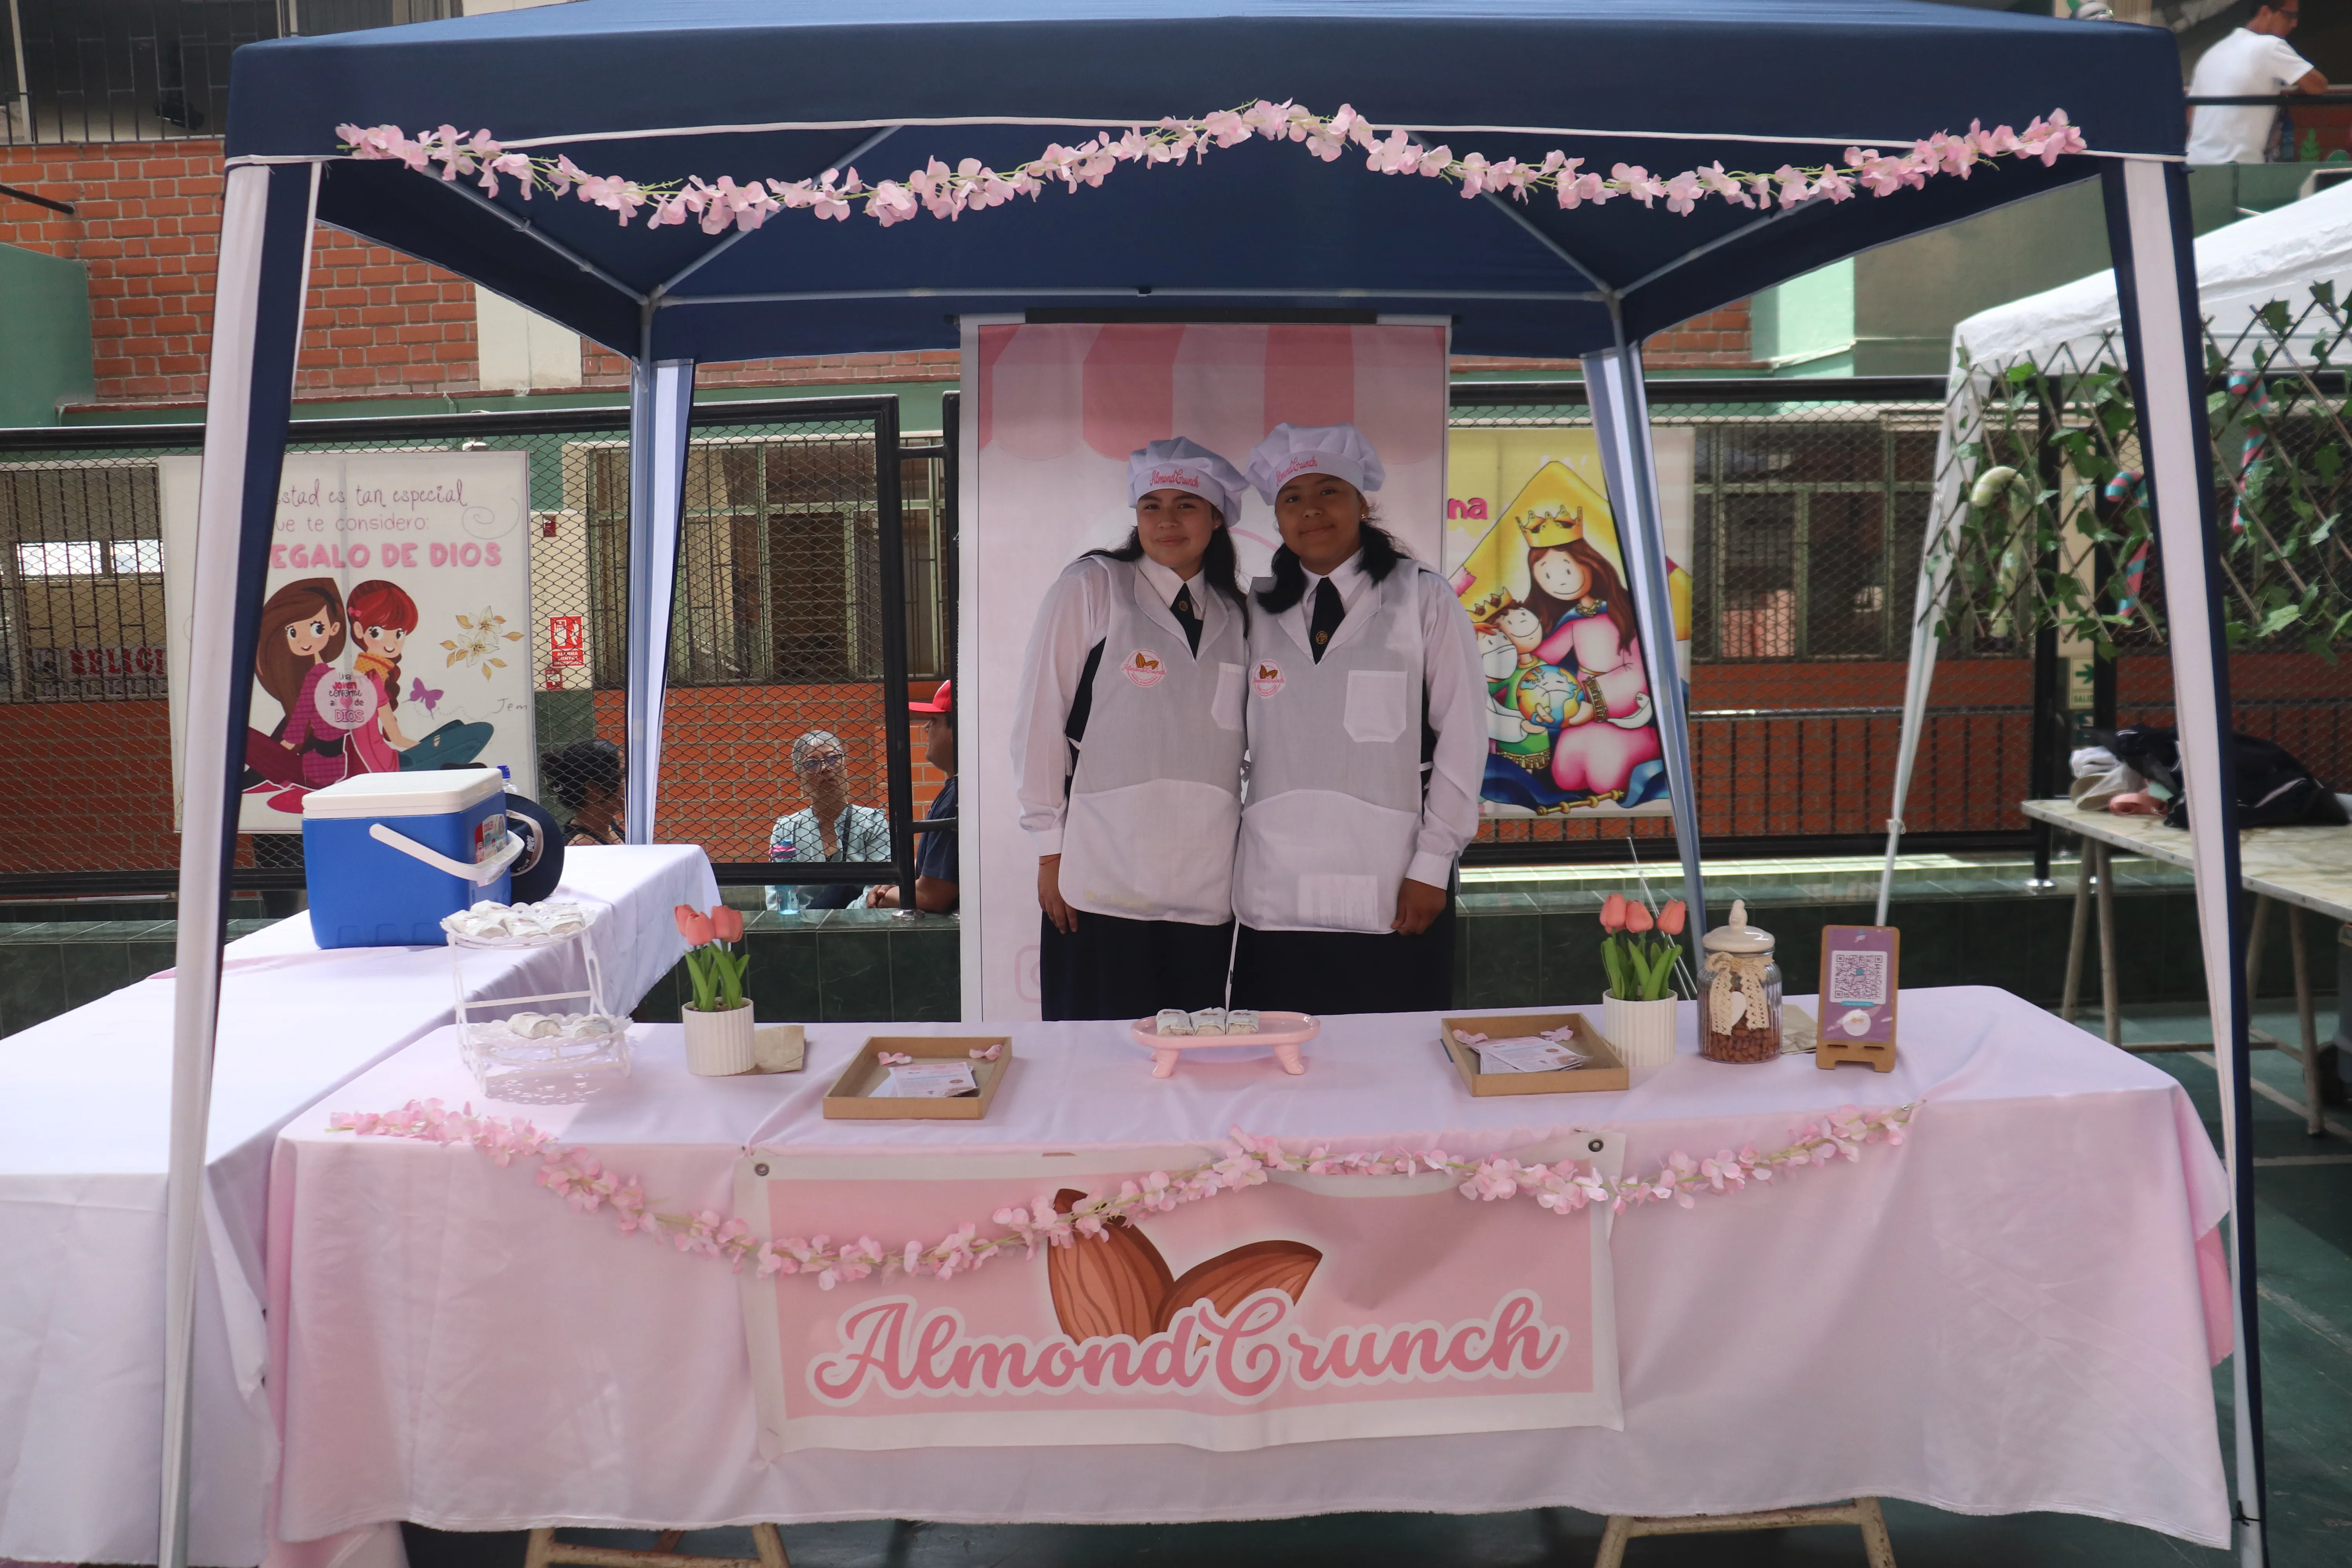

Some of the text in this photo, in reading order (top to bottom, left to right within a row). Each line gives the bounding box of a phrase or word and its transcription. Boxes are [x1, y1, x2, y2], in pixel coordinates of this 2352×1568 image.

[277, 479, 467, 511] stad es tan especial
[1447, 497, 1488, 520] na
[274, 519, 295, 532] ue
[307, 517, 324, 532] te
[271, 542, 502, 568] EGALO DE DIOS
[69, 648, 165, 675] RELIGI
[354, 698, 364, 706] de
[2074, 694, 2094, 703] SALID
[335, 709, 365, 722] DIOS
